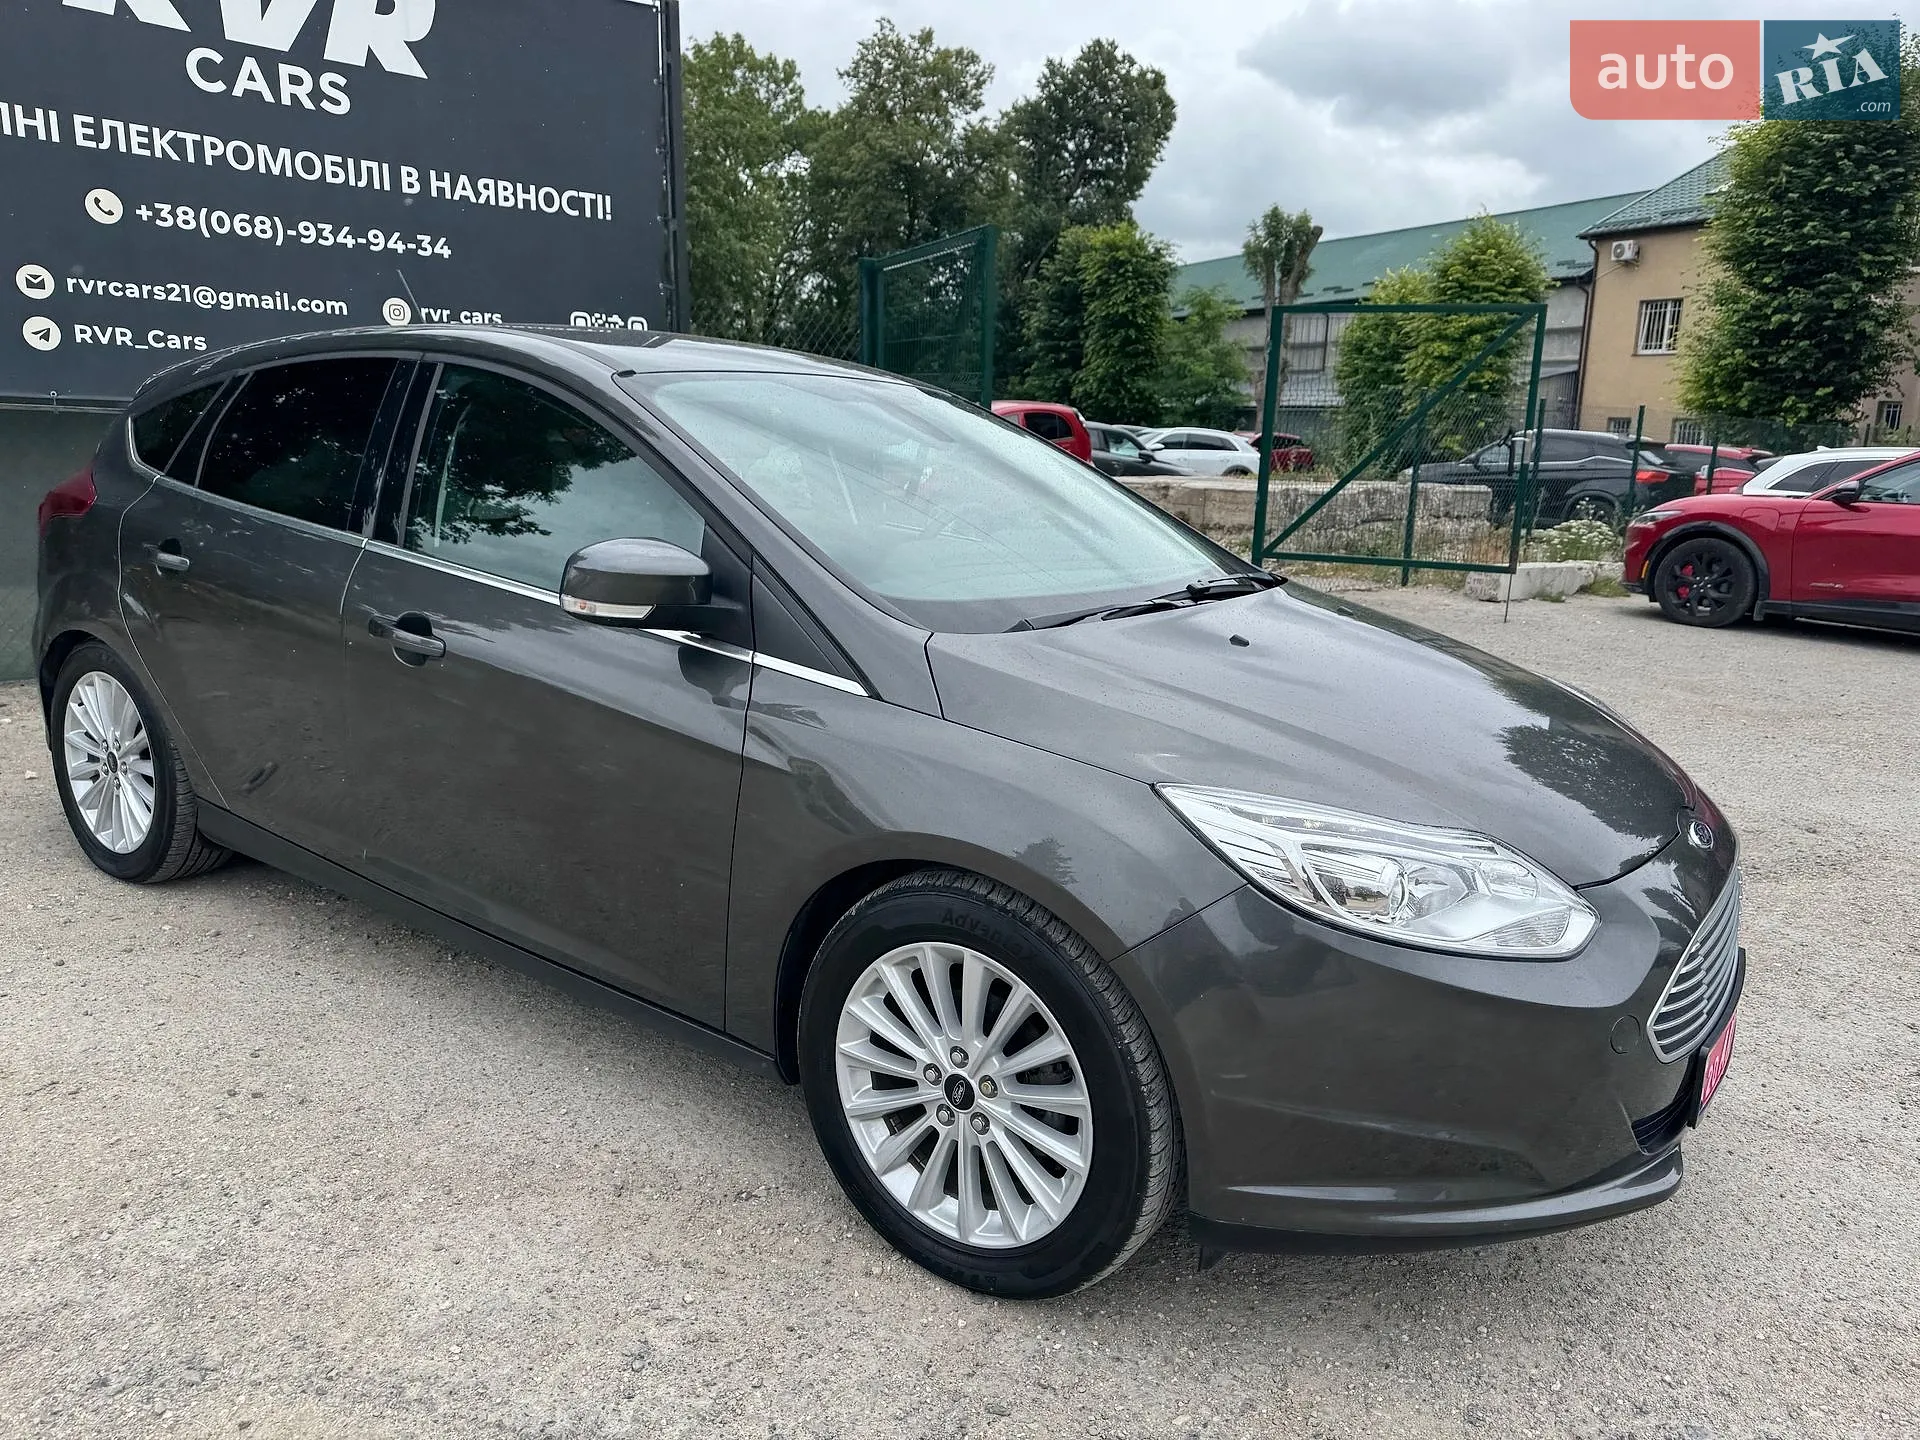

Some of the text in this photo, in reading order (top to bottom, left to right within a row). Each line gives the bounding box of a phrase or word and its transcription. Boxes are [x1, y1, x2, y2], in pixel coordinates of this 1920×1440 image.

[185, 47, 351, 116] CARS
[73, 113, 391, 191] ЕЛЕКТРОМОБІЛІ
[400, 165, 421, 196] В
[429, 169, 612, 221] НАЯВНОСТІ!
[135, 202, 452, 260] +38(068)-934-94-34
[65, 277, 348, 318] rvrcars21@gmail.com
[420, 305, 503, 325] rvr_cars
[73, 323, 208, 353] RVR_Cars
